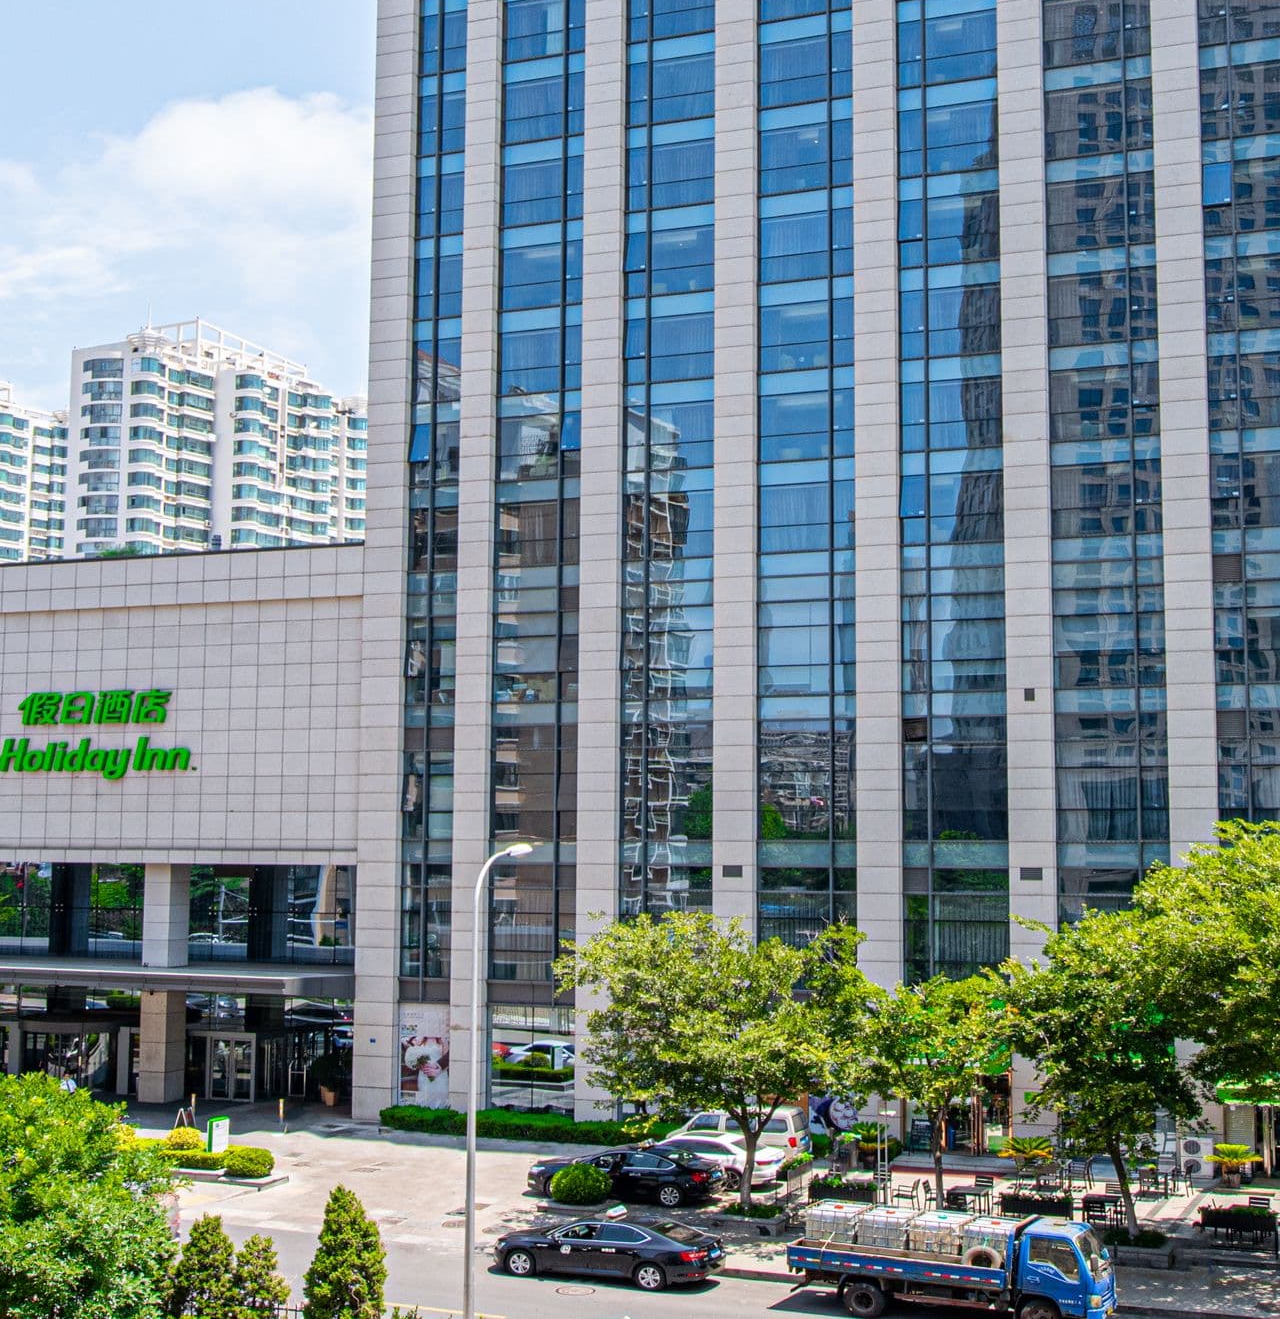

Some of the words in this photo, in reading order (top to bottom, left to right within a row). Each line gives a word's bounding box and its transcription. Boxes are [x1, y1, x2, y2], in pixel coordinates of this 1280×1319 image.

[19, 689, 172, 726] 假日酒店
[132, 736, 191, 772] Inn
